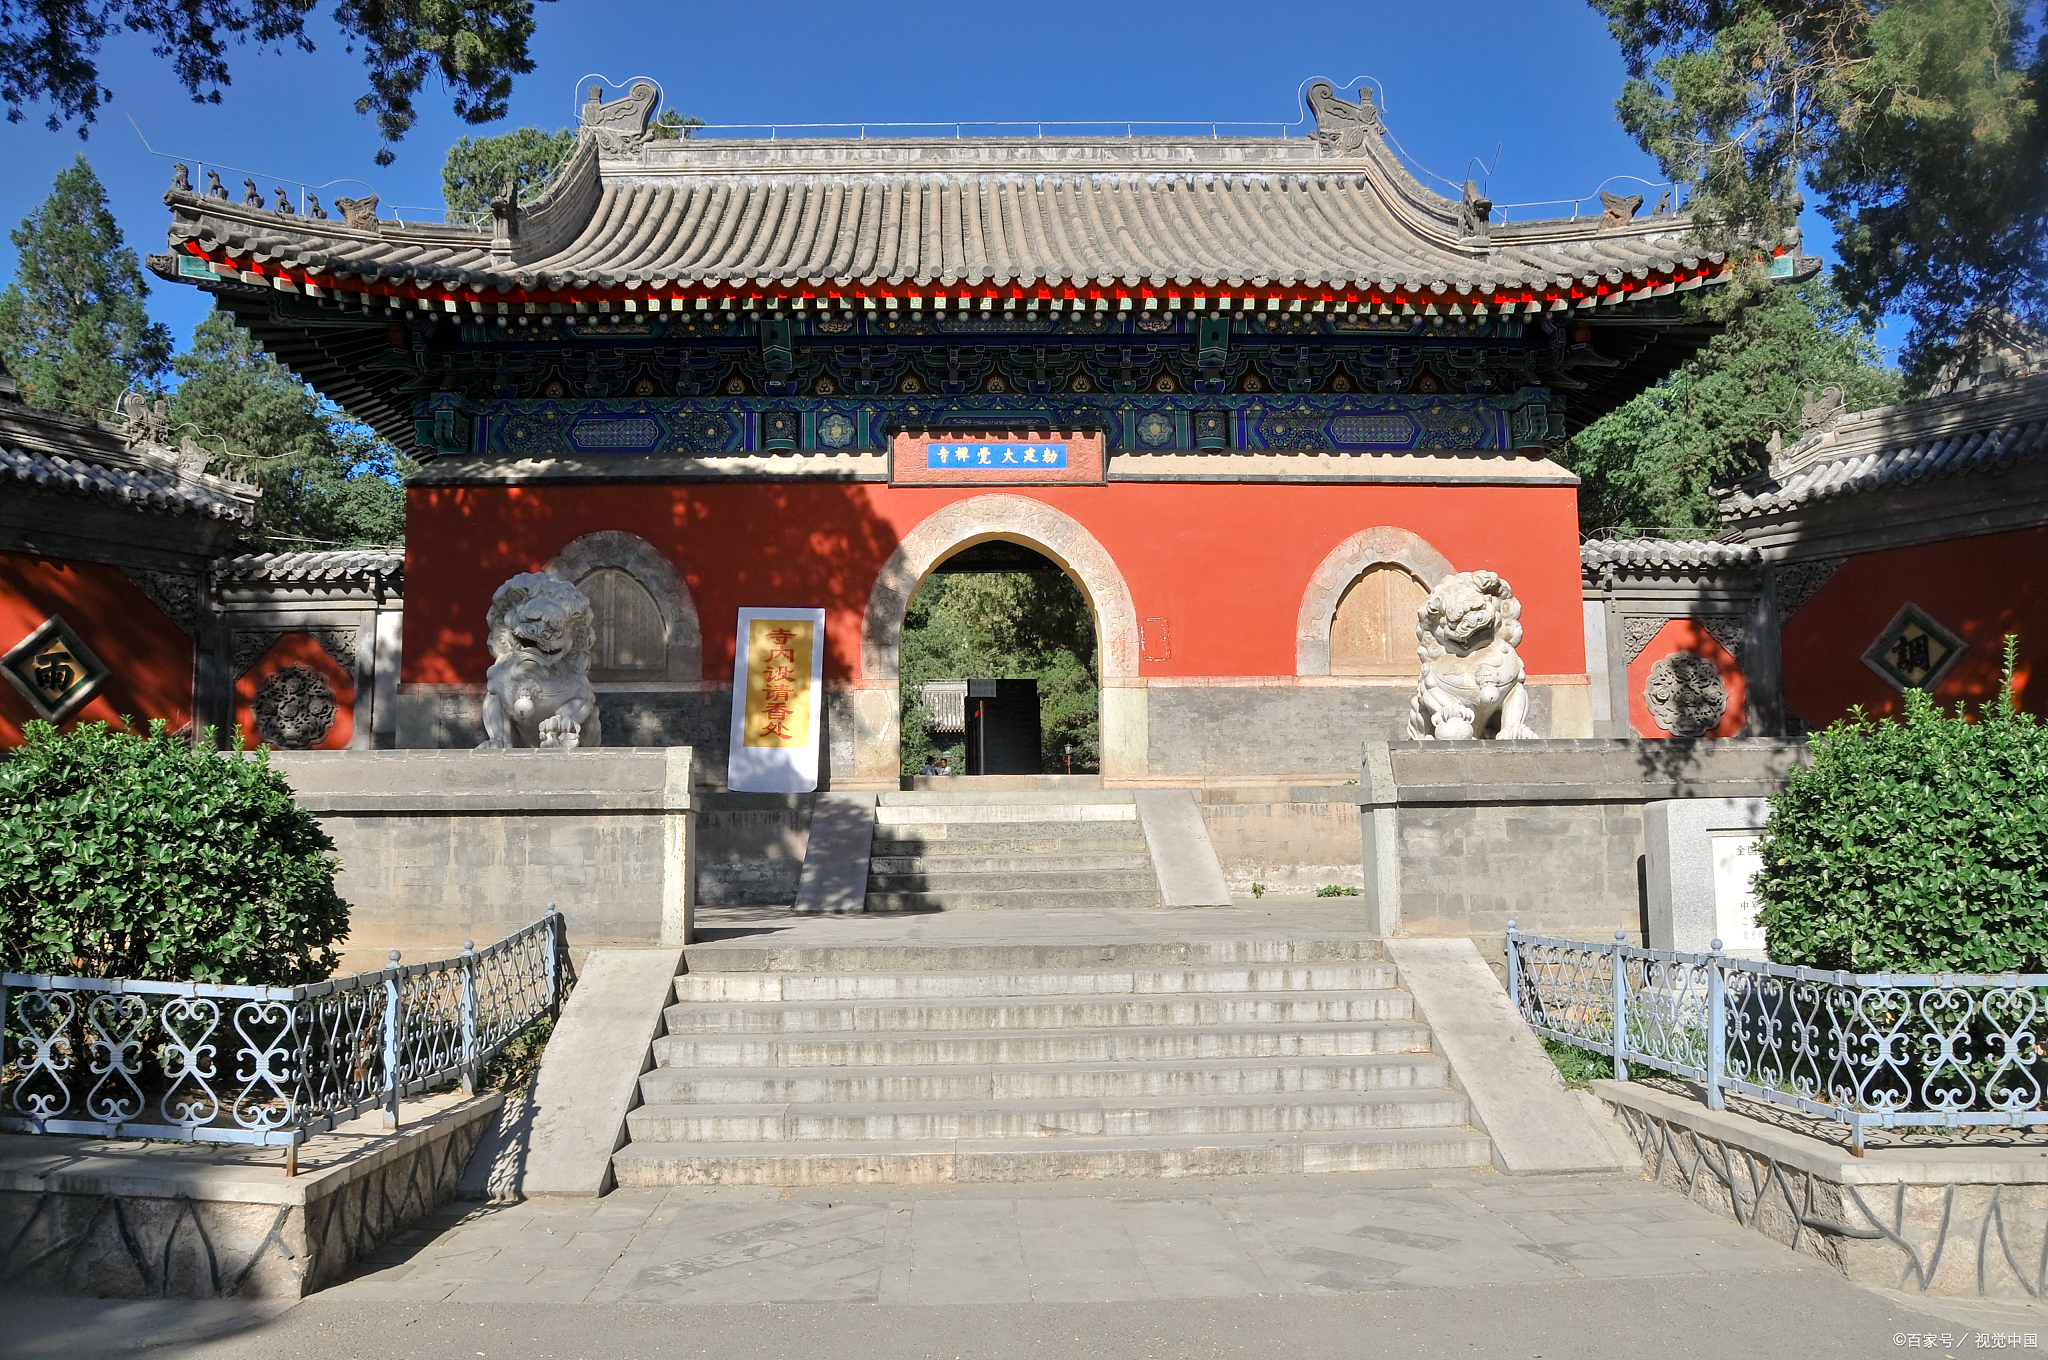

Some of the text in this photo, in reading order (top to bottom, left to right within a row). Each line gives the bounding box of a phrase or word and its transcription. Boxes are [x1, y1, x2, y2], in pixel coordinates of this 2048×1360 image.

[34, 651, 76, 691] 雨
[759, 627, 798, 740] 寺内设请香处
[1736, 844, 1763, 857] 全国
